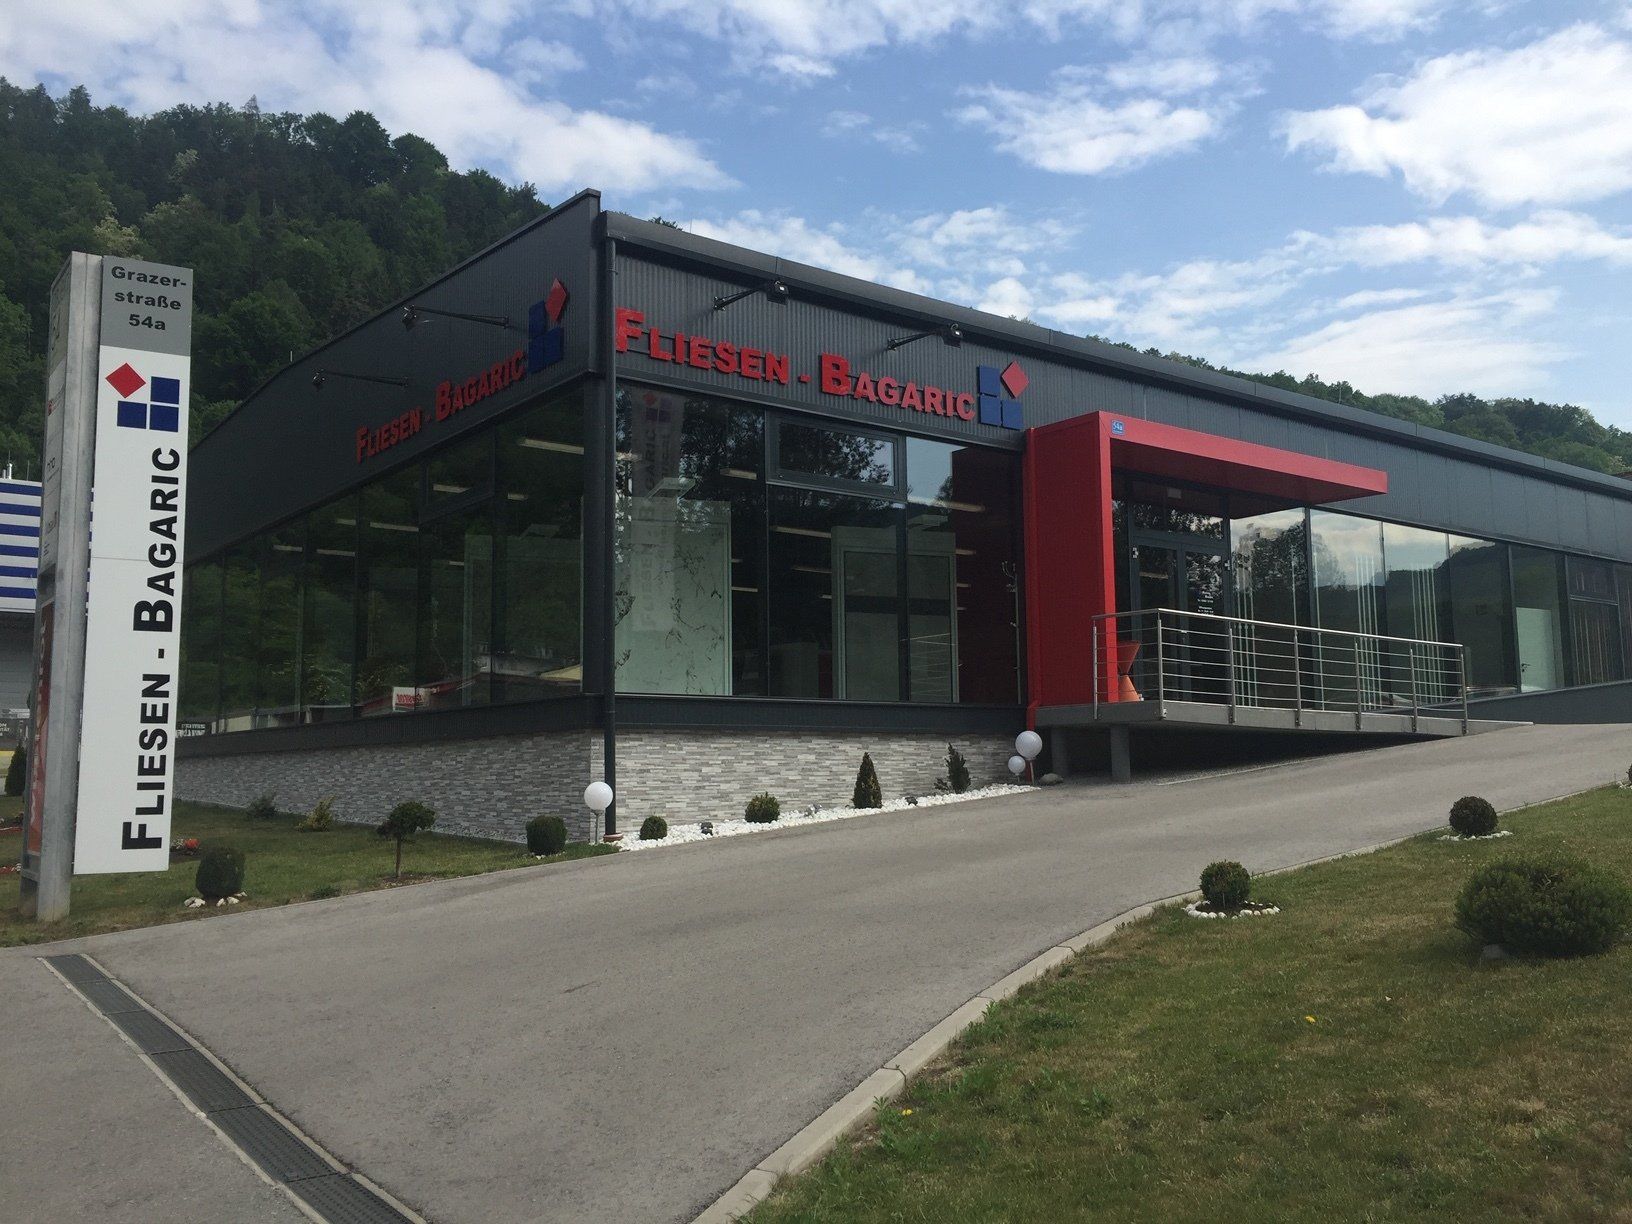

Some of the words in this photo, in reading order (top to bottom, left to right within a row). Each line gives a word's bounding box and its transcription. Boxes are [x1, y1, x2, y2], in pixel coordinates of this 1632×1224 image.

[111, 265, 187, 288] Grazer-
[114, 290, 181, 311] straße
[128, 313, 166, 331] 54a
[356, 407, 423, 463] FLIESEN
[435, 351, 526, 422] BAGARIC
[616, 307, 789, 385] FLIESEN
[821, 352, 976, 421] BAGARIC
[133, 448, 180, 633] BAGARIC
[121, 673, 171, 850] FLIESEN
